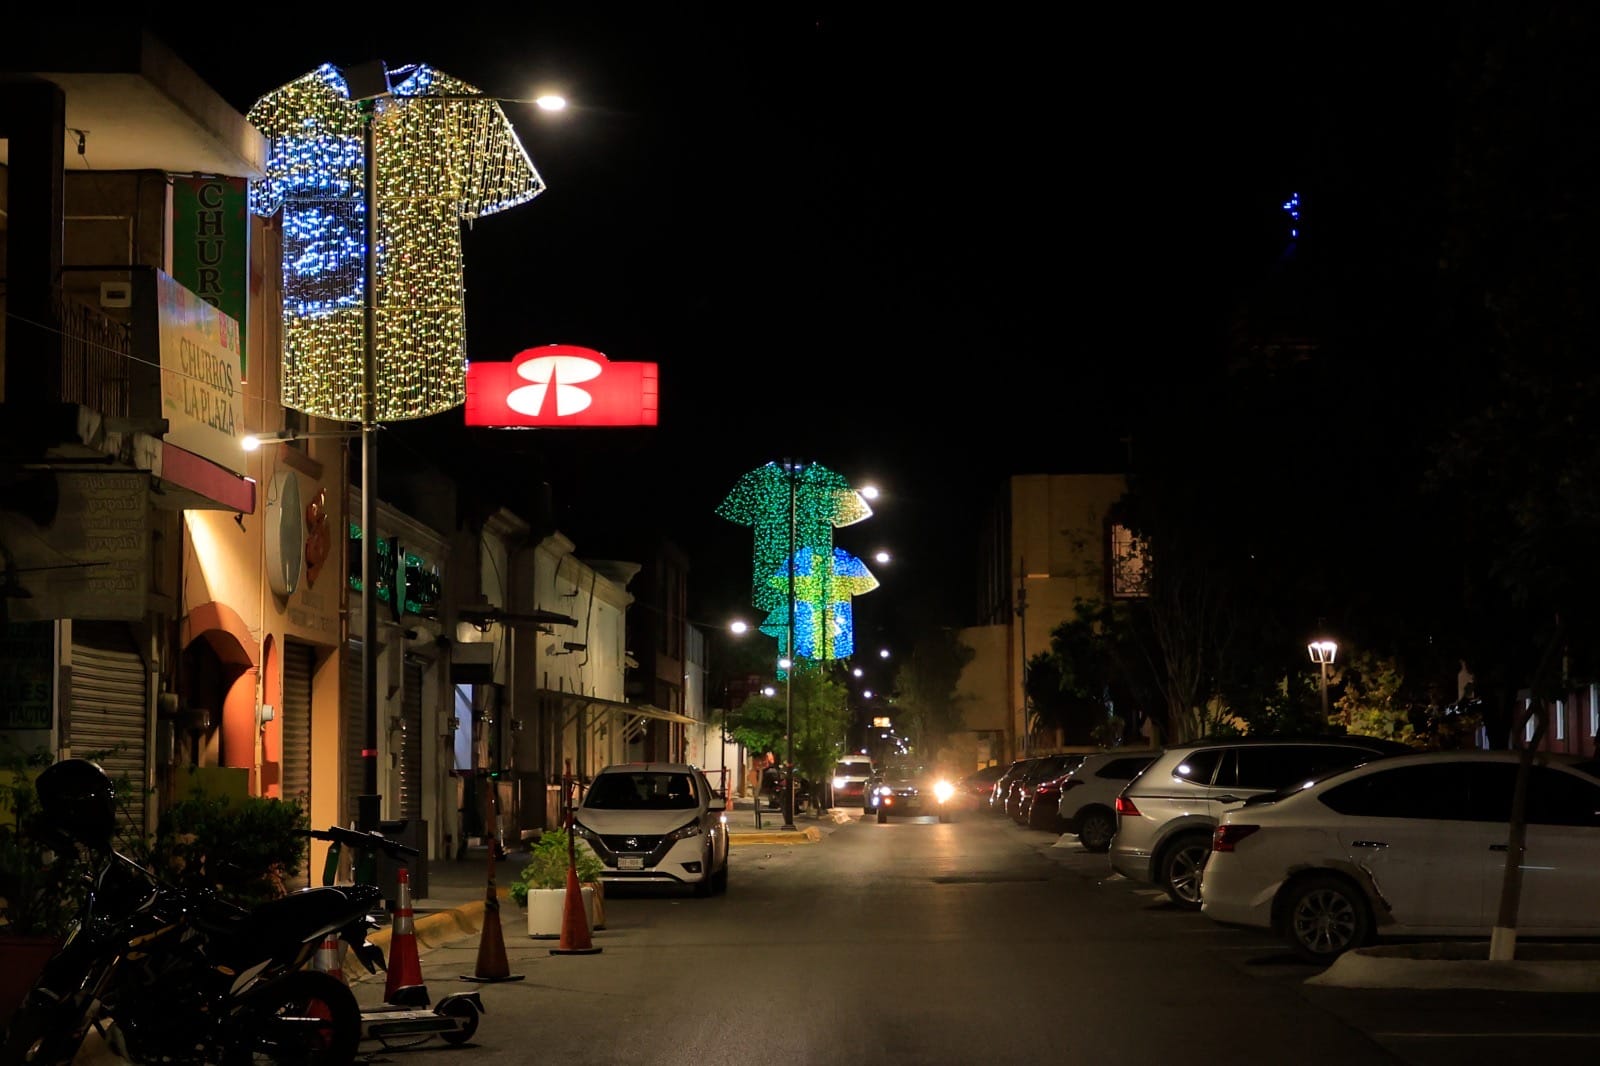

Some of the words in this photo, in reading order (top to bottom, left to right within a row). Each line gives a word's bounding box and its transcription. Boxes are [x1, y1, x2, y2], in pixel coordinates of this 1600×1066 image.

[180, 336, 233, 398] CHURROS
[183, 378, 200, 420] LA
[200, 387, 236, 437] PLAZA
